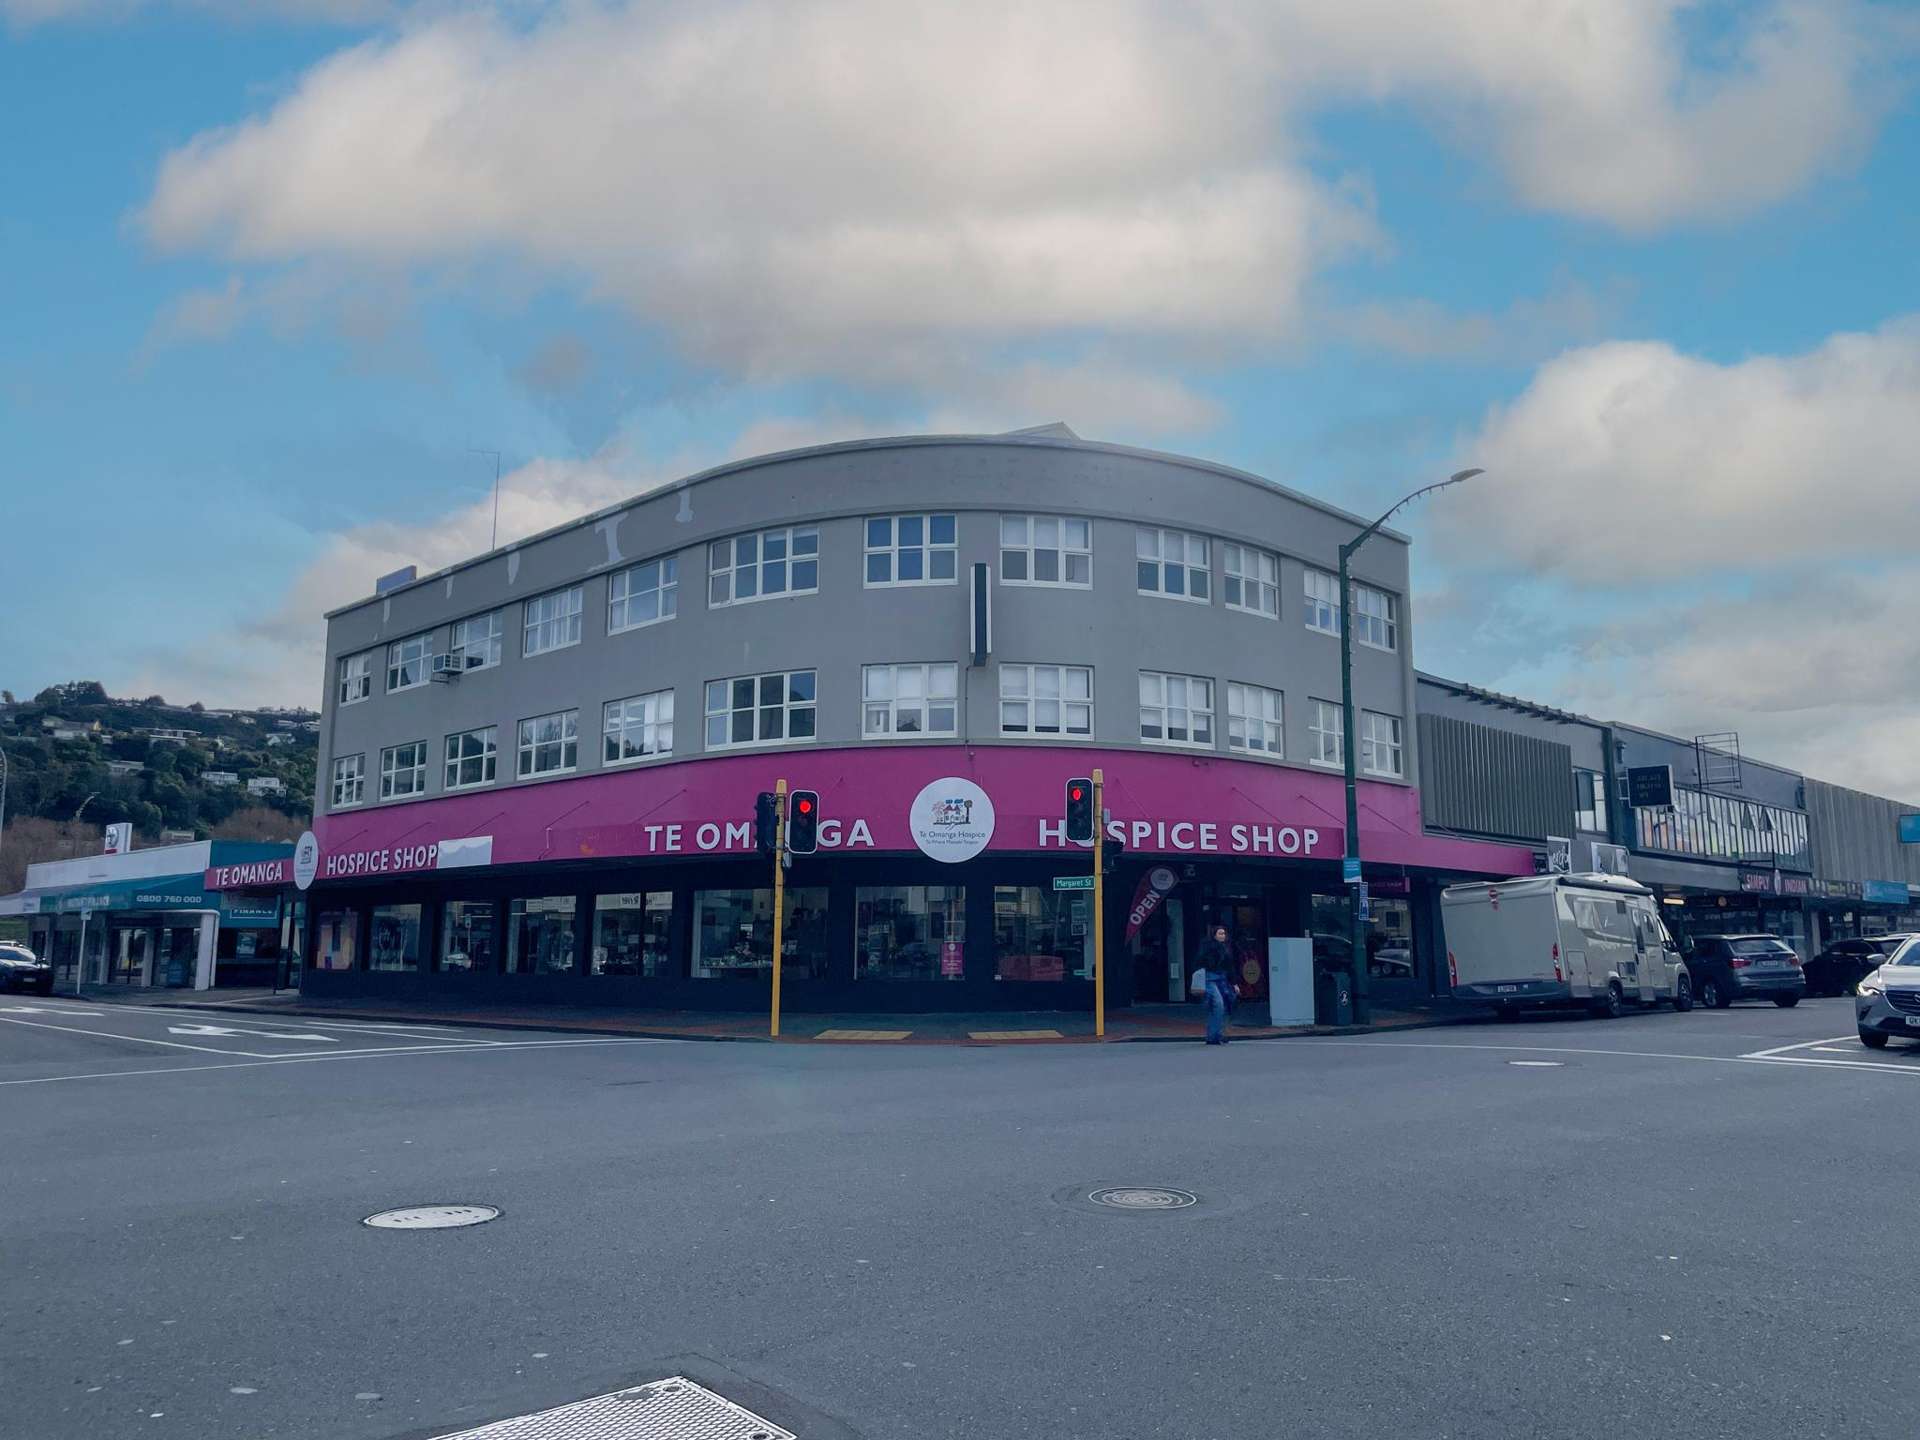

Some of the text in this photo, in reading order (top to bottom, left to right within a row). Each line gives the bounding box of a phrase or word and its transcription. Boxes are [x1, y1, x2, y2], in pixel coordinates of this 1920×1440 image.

[644, 819, 875, 852] TE OMGA
[928, 831, 957, 839] Omanga
[958, 830, 986, 839] Hospice
[1039, 819, 1320, 855] HSPICE SHOP
[326, 844, 438, 876] HOSPICE SHOP
[215, 868, 229, 886] TE
[231, 861, 283, 884] OMANGA
[1056, 878, 1092, 888] Margaret St
[1746, 874, 1770, 890] SIMPLY
[1784, 879, 1808, 893] INDIAN
[136, 895, 162, 903] 0800
[1130, 890, 1161, 925] OPEN
